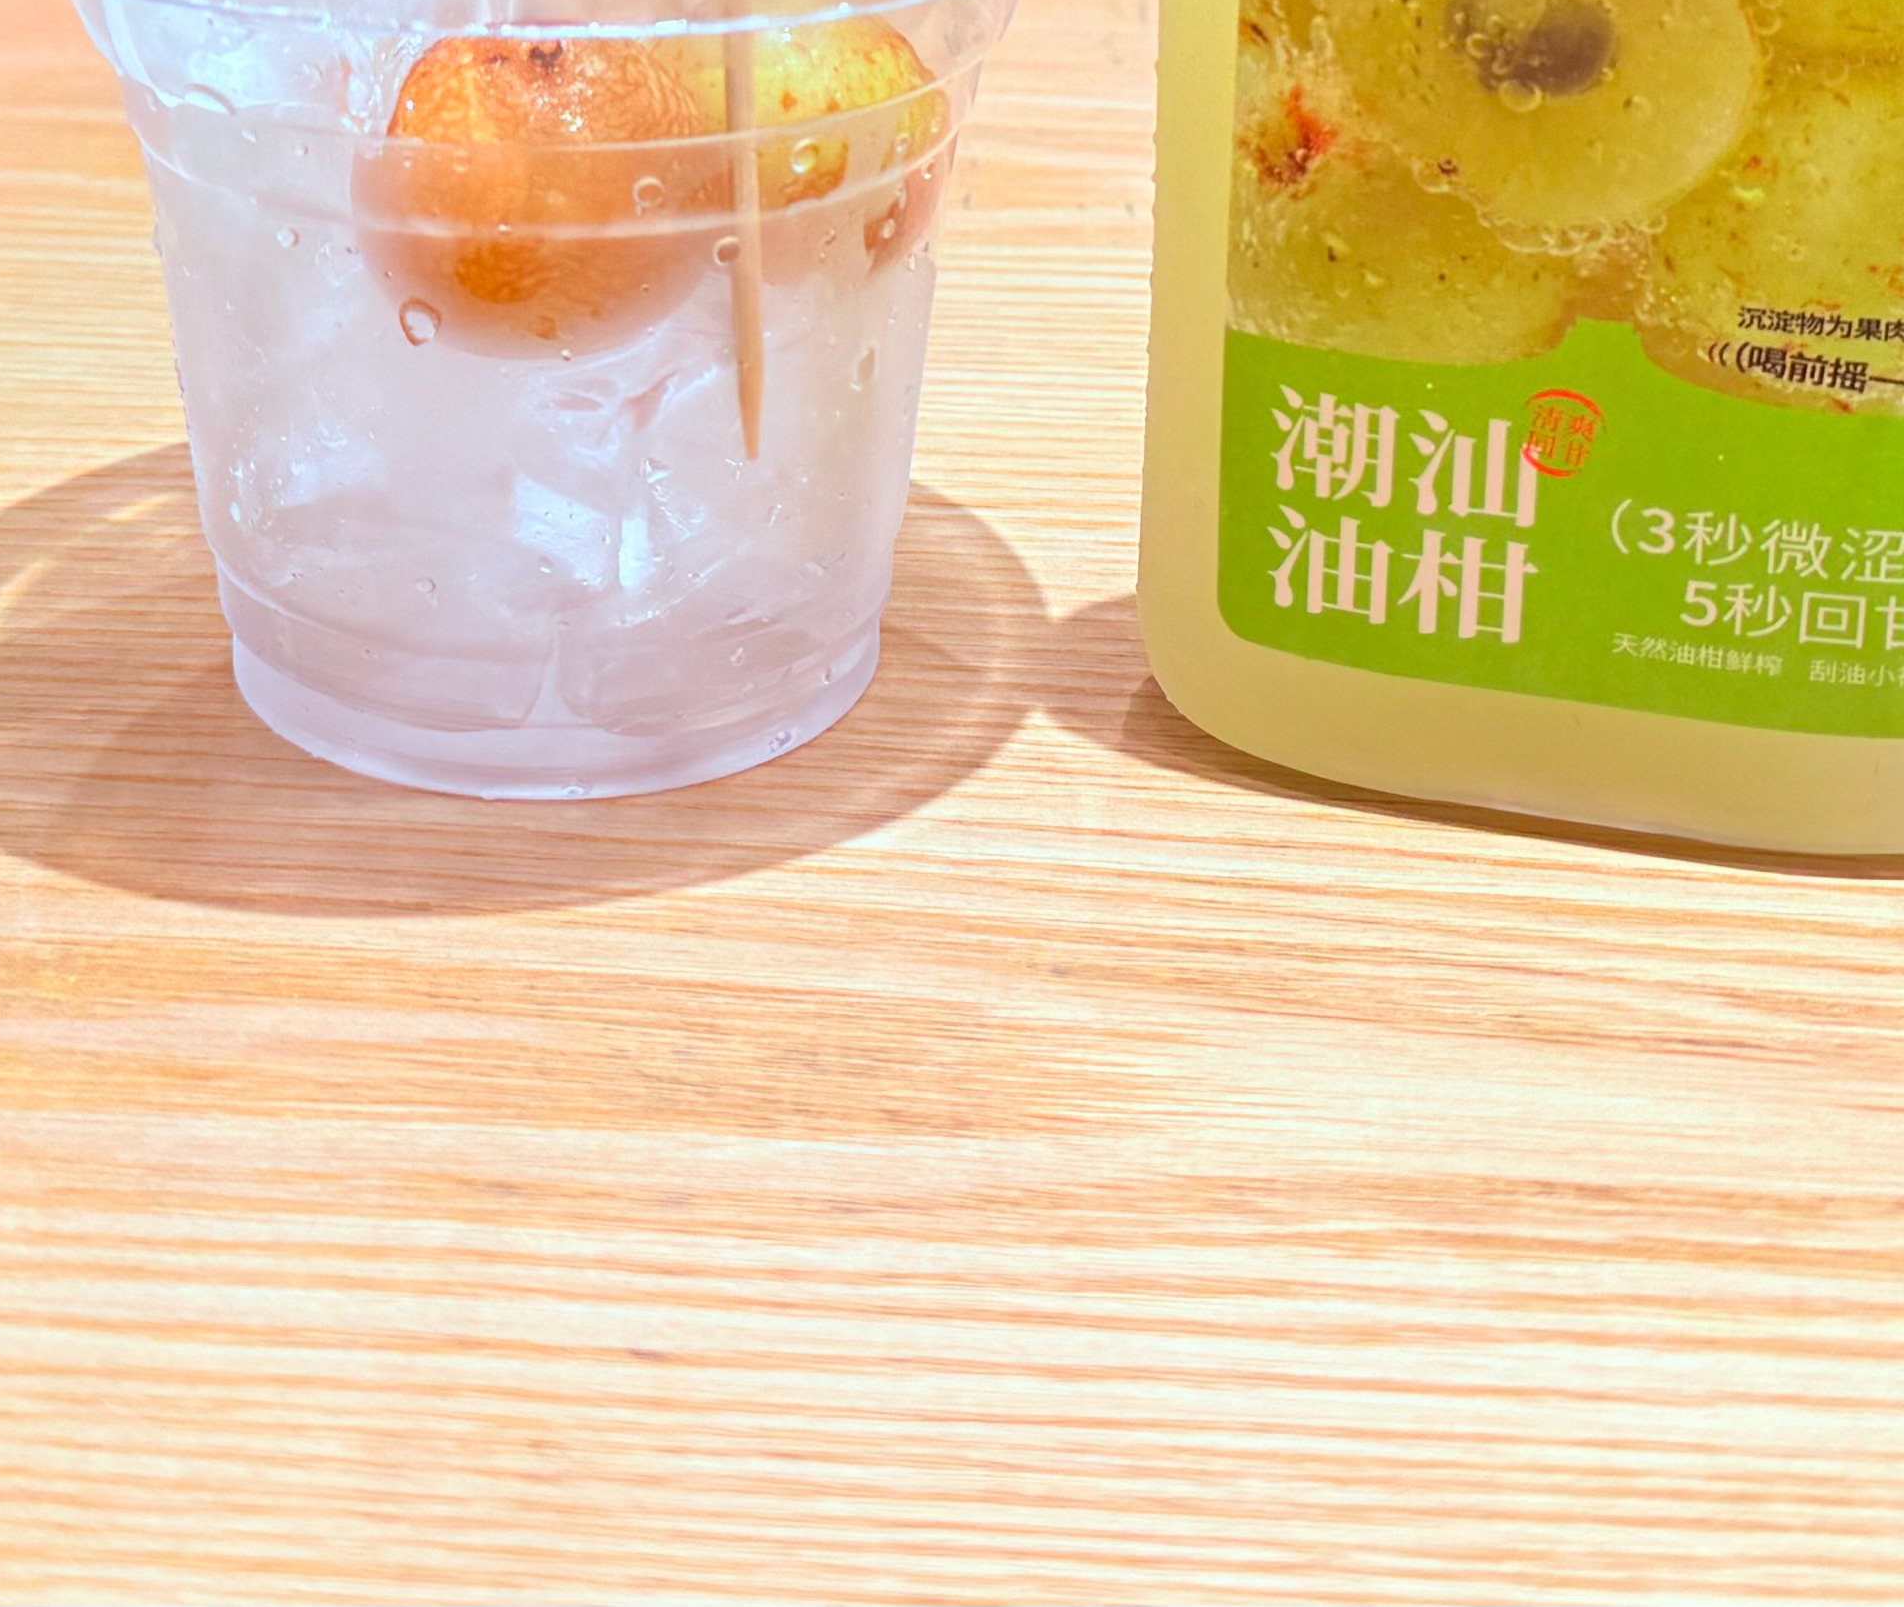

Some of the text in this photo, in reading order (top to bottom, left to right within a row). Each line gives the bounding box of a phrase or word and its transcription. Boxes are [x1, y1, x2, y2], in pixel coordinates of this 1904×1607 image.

[1269, 383, 1540, 528] 潮汕
[1266, 504, 1540, 644] 油柑
[1611, 631, 1784, 677] 天然油柑鲜榨
